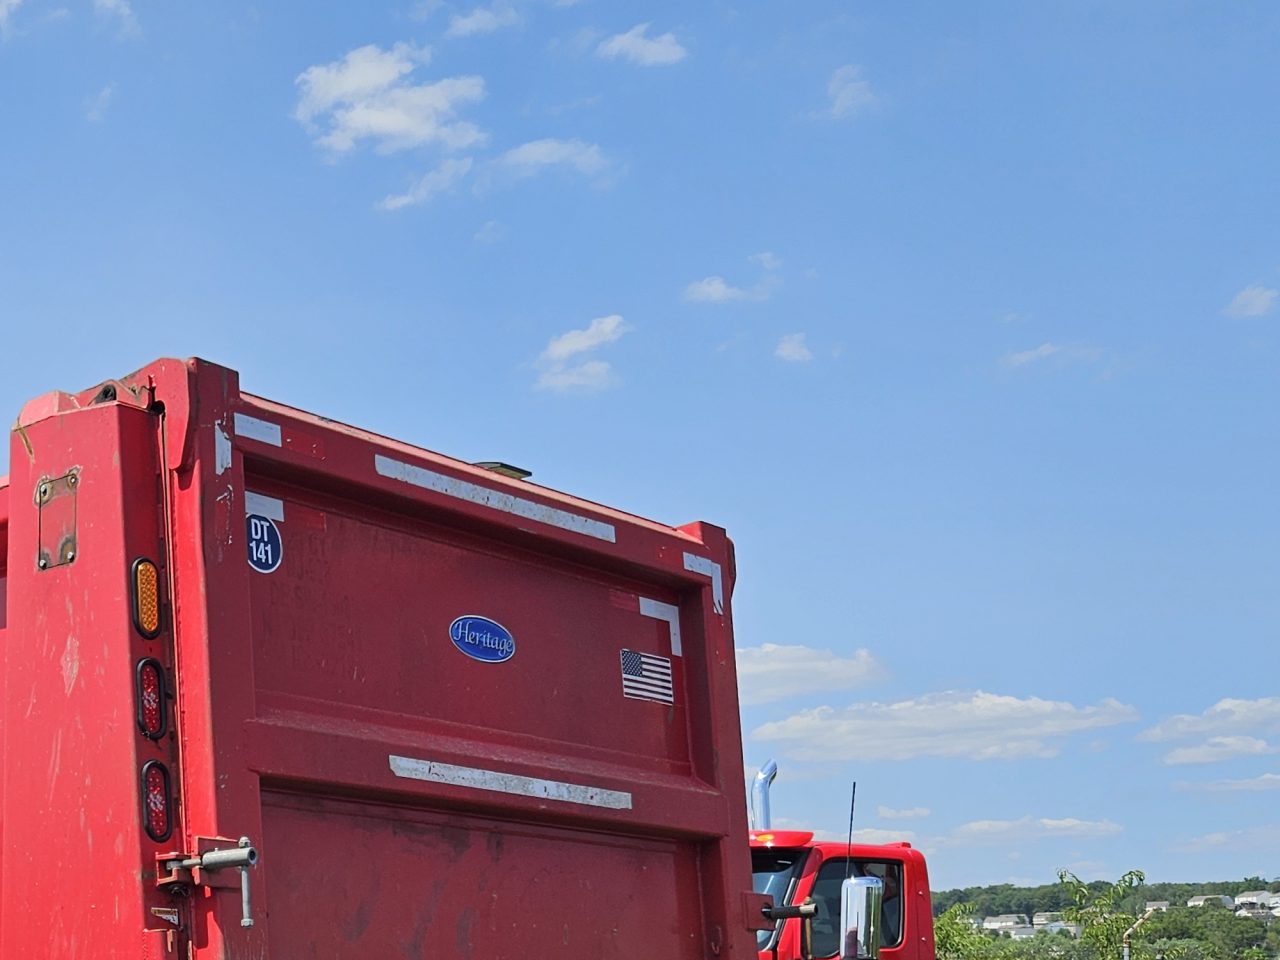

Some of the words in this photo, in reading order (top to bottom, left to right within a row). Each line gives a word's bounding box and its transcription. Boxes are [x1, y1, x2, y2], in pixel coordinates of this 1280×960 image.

[250, 518, 270, 542] DT
[249, 540, 272, 565] 141
[453, 620, 513, 657] Heritage
